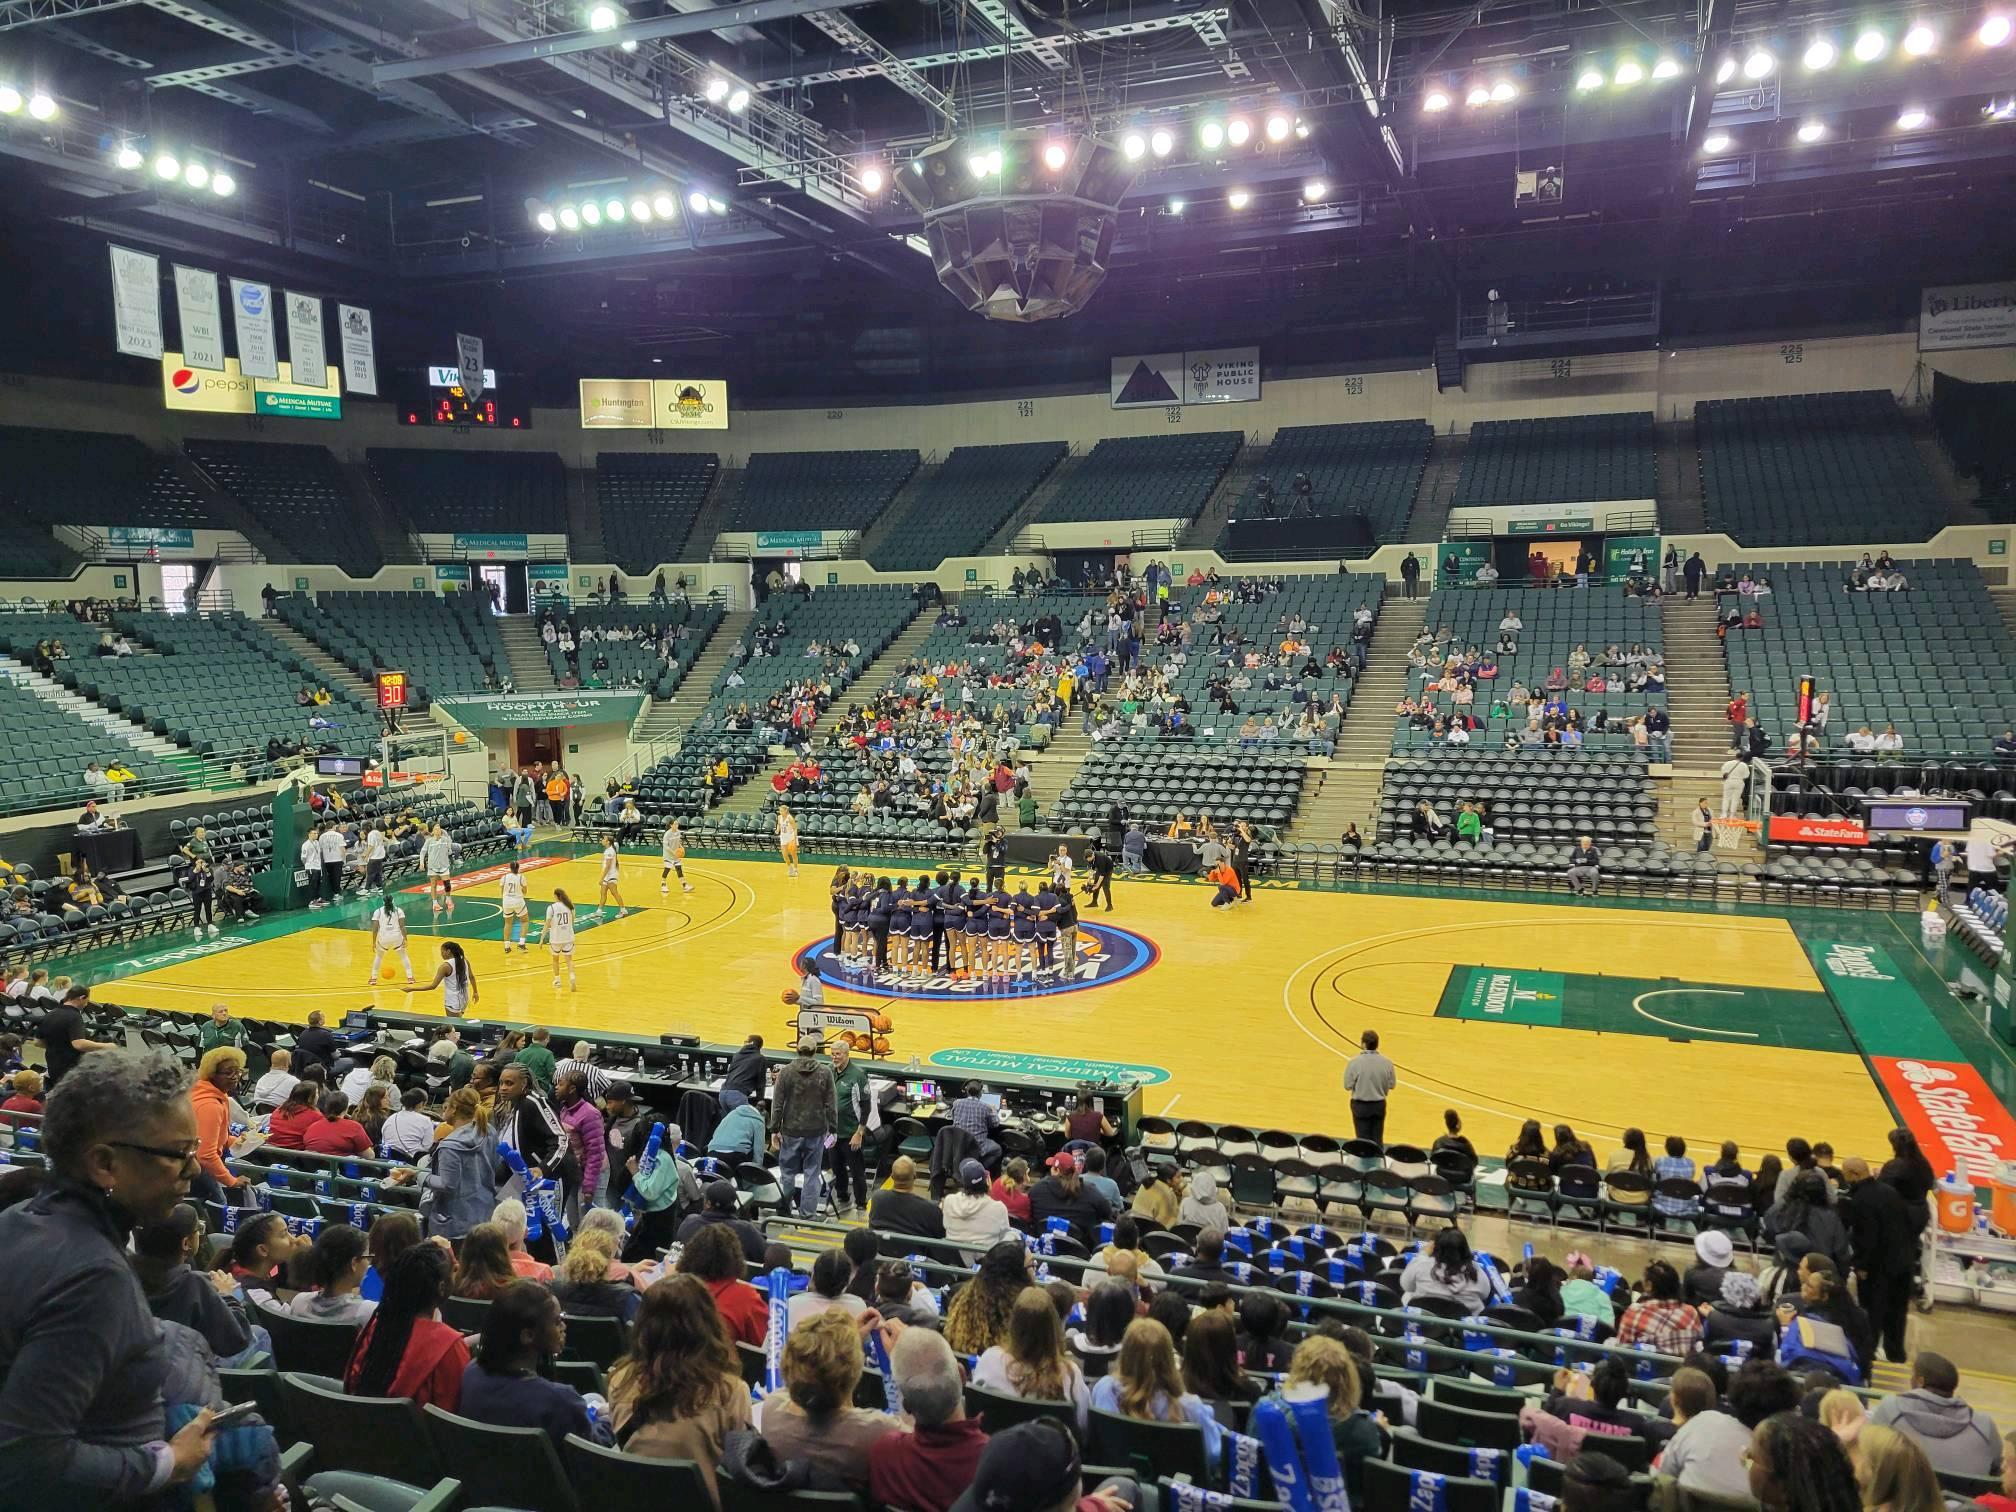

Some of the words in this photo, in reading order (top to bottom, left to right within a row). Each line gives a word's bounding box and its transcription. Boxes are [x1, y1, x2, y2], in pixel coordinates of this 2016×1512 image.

[128, 336, 153, 348] 2023
[1781, 344, 1803, 353] 225
[192, 351, 214, 362] 2021
[1784, 354, 1803, 364] 125
[464, 356, 478, 372] 23
[1217, 361, 1254, 370] VIKING
[1217, 369, 1254, 378] PUBLIC
[204, 378, 249, 393] pepsi
[1217, 378, 1254, 386] HOUSE
[1345, 377, 1363, 385] 223
[1347, 387, 1363, 395] 123
[443, 401, 450, 410] 0
[487, 403, 493, 412] 0
[602, 398, 644, 408] Huntington
[1018, 401, 1033, 409] 221
[1166, 407, 1181, 415] 222
[385, 686, 401, 704] 30
[1815, 827, 1864, 839] StateFarm
[508, 883, 516, 893] 21
[557, 912, 568, 925] 20
[1484, 974, 1512, 1014] McLENDON
[826, 1015, 855, 1025] Wilson
[987, 1052, 1018, 1060] Vision
[1032, 1056, 1071, 1065] Dental
[943, 1054, 1022, 1069] MUTUAL
[1027, 1062, 1113, 1079] MEDICAL
[1910, 1083, 2005, 1186] StateFarm
[1949, 1201, 1967, 1217] G
